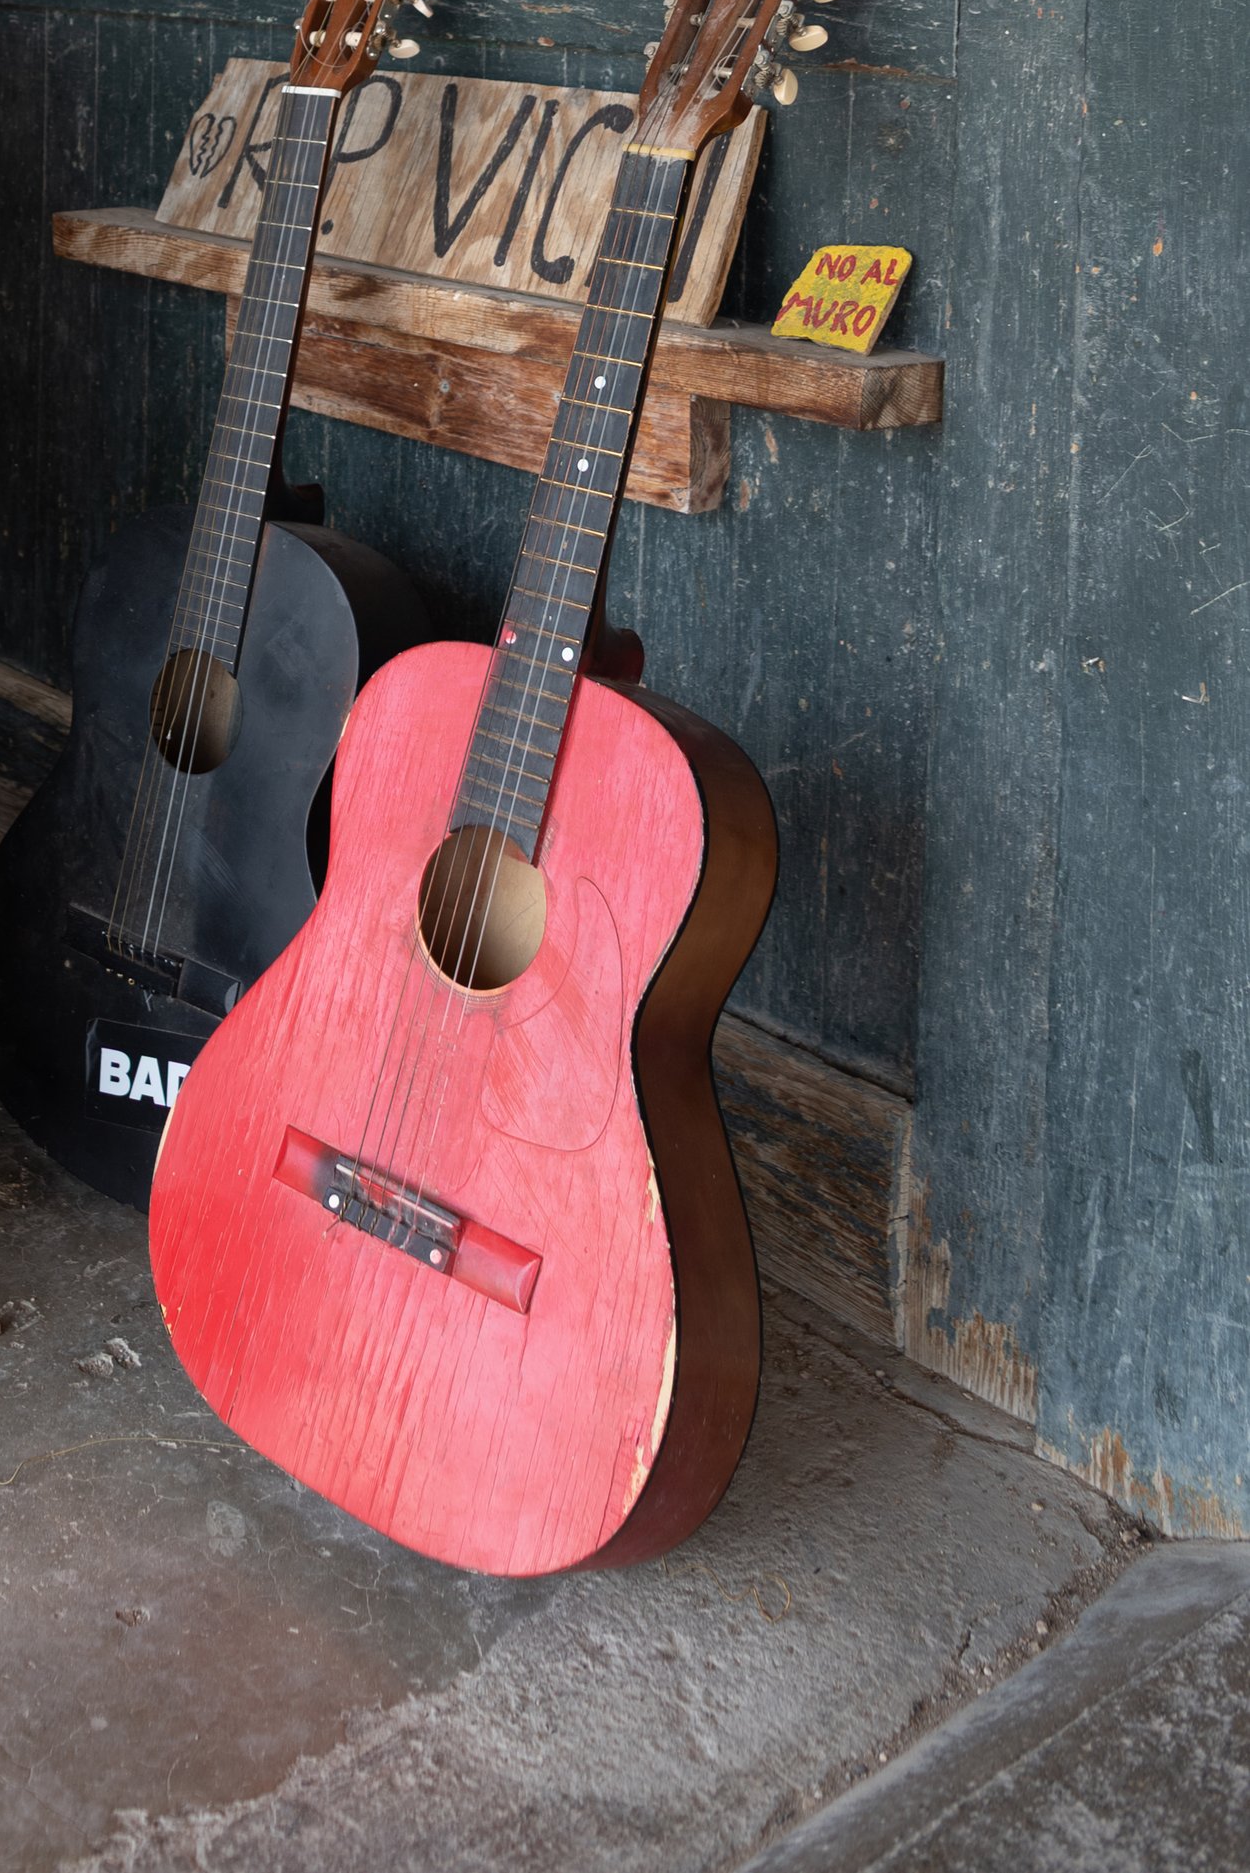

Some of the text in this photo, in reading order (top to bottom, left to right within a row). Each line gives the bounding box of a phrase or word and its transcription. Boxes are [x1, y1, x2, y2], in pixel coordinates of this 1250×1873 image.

[815, 252, 899, 286] NO AL
[776, 291, 877, 337] MURO
